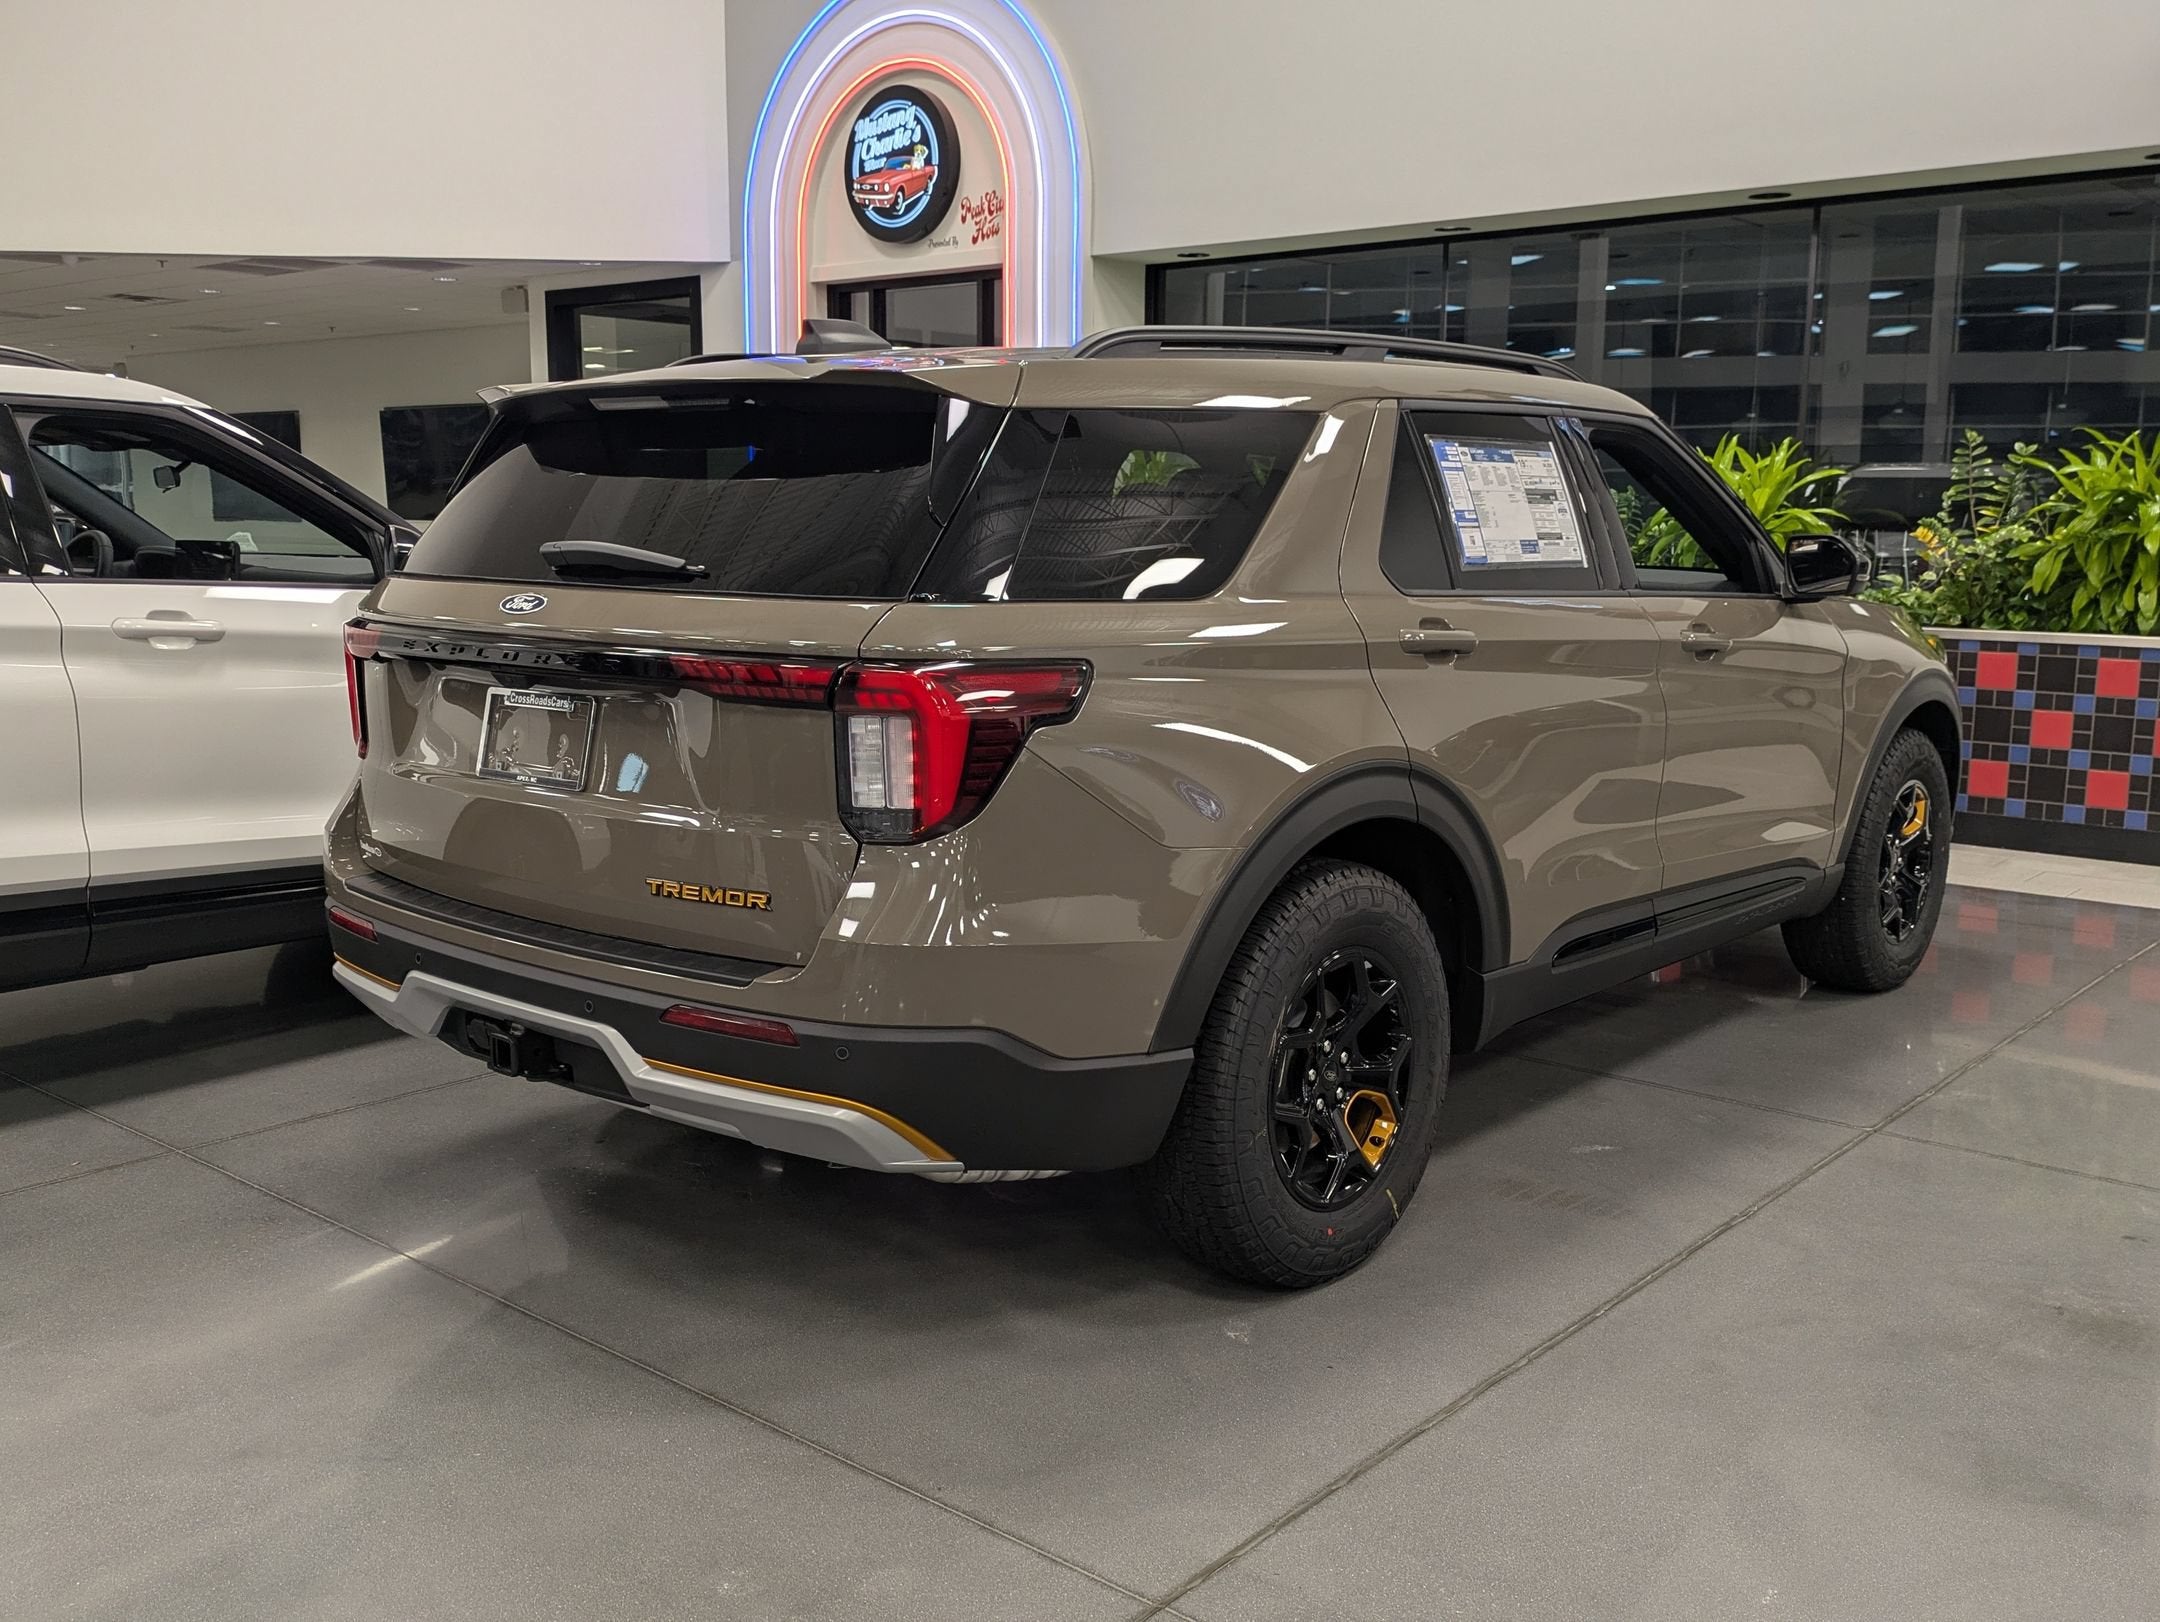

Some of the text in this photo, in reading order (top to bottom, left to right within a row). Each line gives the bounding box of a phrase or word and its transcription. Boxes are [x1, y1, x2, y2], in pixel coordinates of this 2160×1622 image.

[854, 105, 917, 143] Mustang
[861, 124, 922, 161] Charlie's
[503, 594, 542, 612] Ford
[402, 637, 621, 671] EXPLORER
[645, 876, 773, 911] TREMOR
